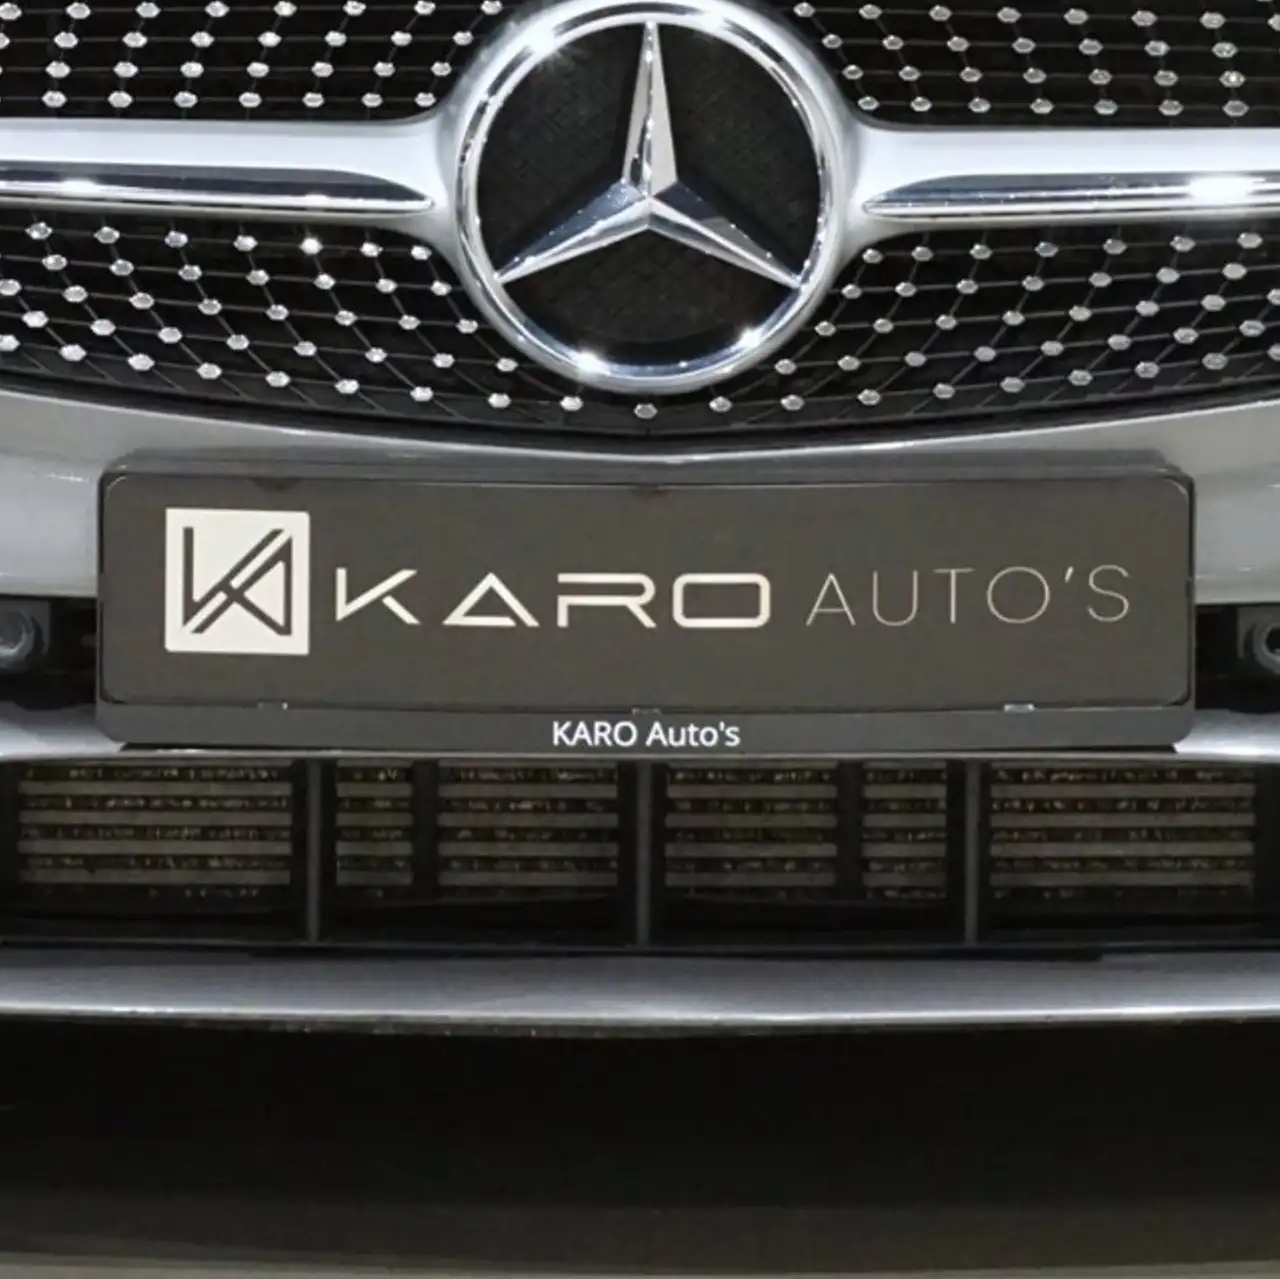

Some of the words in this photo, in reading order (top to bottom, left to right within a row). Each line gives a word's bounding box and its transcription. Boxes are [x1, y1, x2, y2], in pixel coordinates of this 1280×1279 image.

[334, 565, 773, 630] KARO
[804, 563, 1131, 629] AUTO'S
[551, 720, 639, 748] KARO
[644, 720, 742, 748] Auto's
